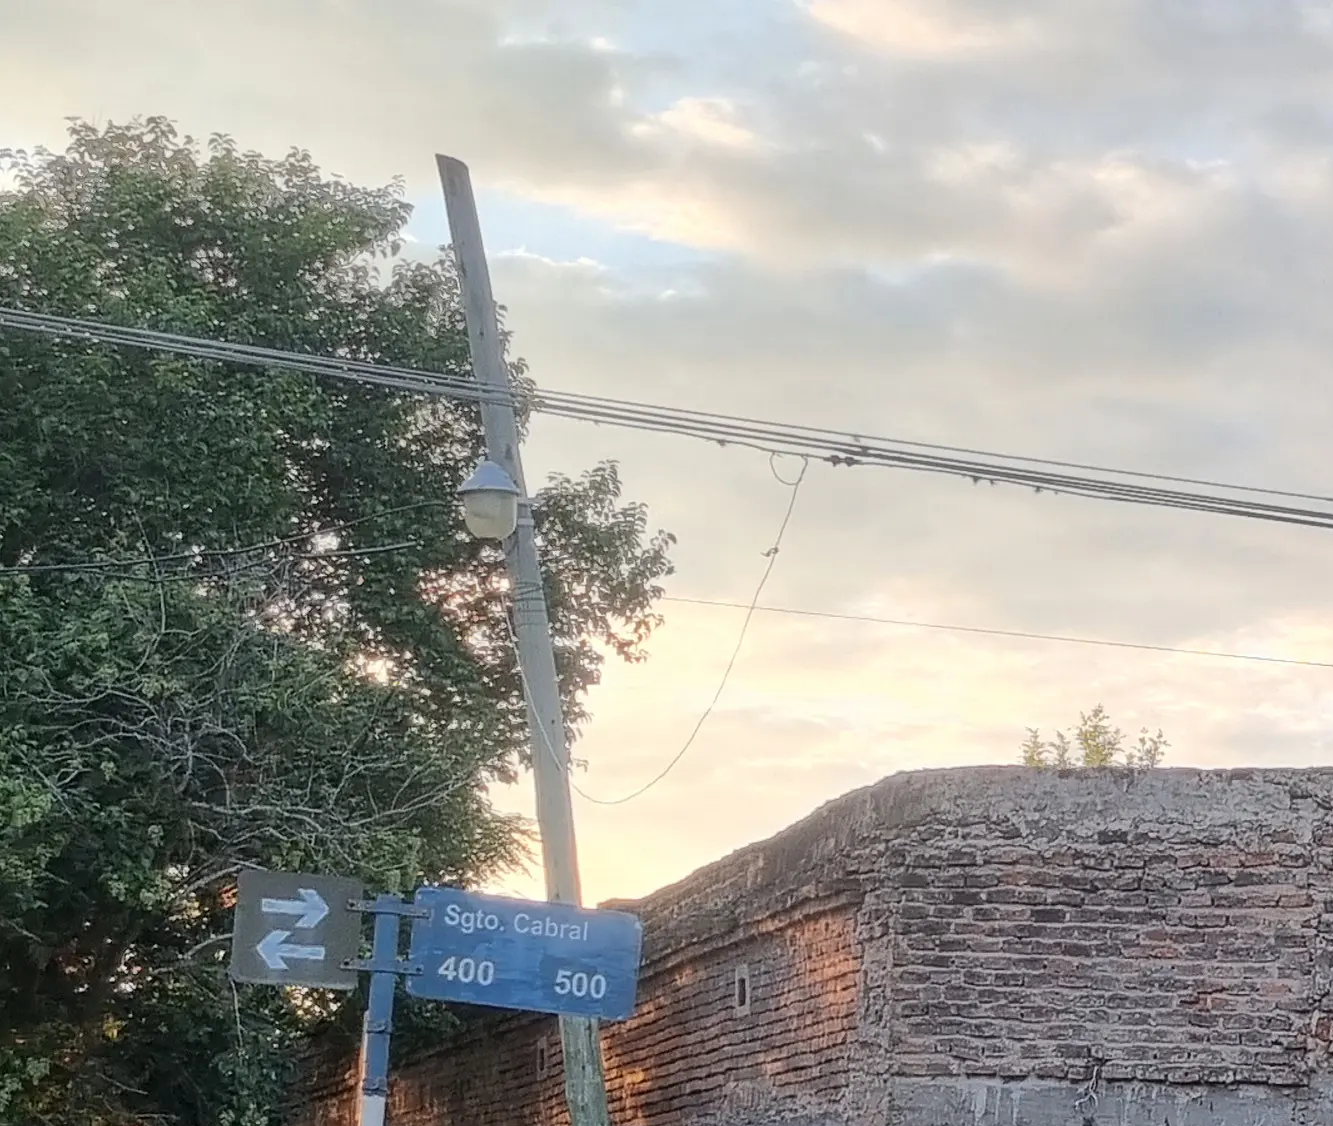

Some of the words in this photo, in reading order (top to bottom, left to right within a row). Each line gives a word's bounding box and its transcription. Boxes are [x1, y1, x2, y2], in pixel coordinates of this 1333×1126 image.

[444, 904, 505, 934] Sgto.
[514, 912, 589, 941] Cabral
[438, 955, 494, 986] 400
[554, 969, 607, 999] 500
